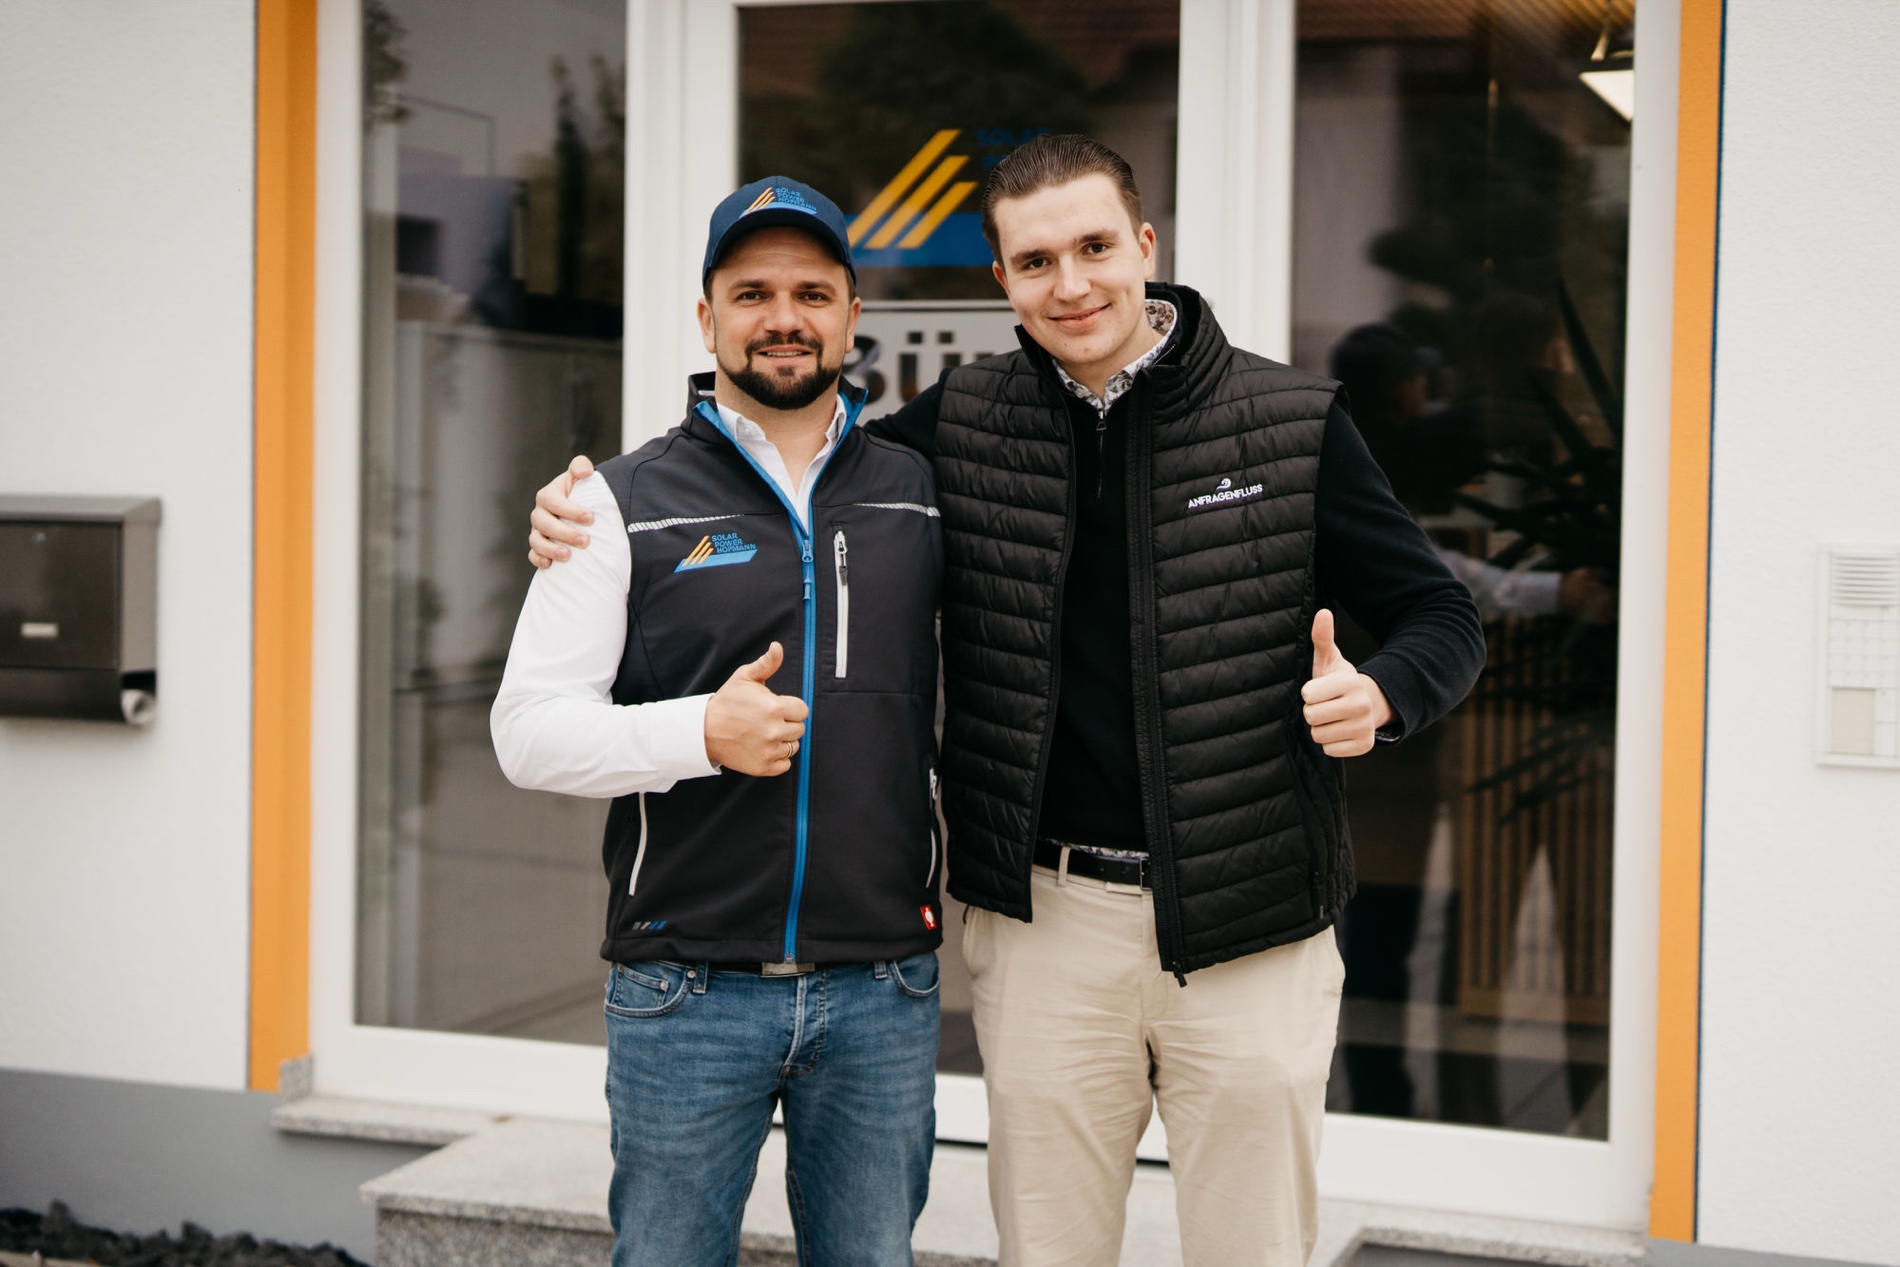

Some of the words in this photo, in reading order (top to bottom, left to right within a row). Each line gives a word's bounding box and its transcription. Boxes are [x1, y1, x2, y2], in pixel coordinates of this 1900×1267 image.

[1188, 484, 1263, 508] ANFRAGENFLUSS
[711, 532, 738, 542] SOLAR
[714, 538, 743, 548] POWER
